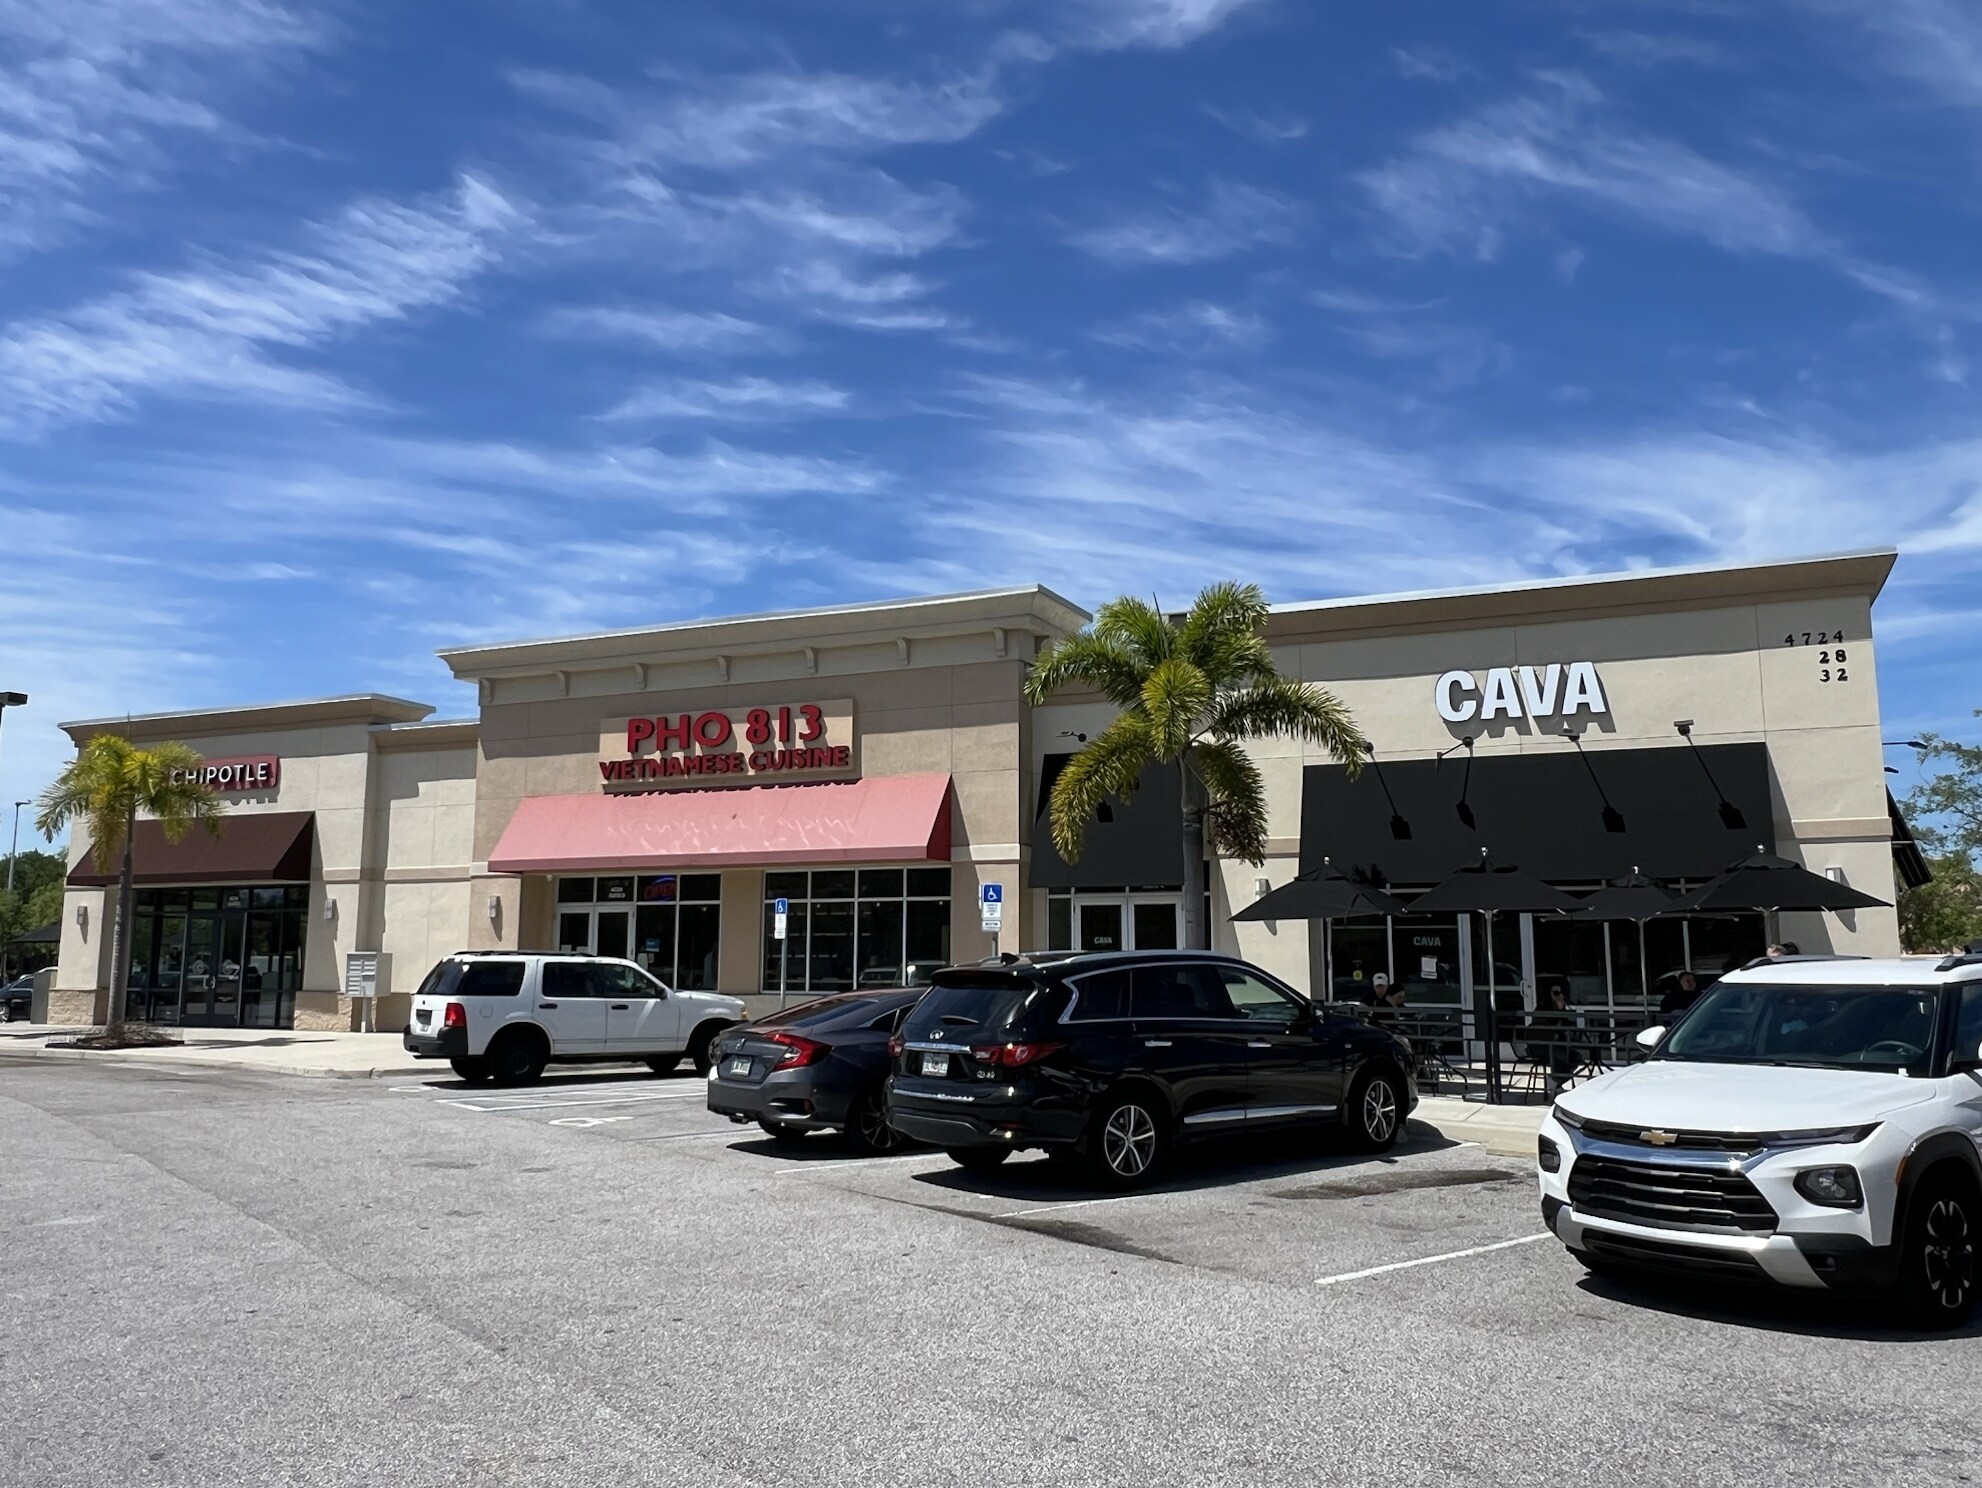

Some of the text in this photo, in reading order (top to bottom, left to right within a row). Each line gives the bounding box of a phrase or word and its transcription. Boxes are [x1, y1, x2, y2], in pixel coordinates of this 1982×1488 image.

[1784, 629, 1844, 647] 4724
[1819, 649, 1847, 663] 28
[1819, 668, 1849, 683] 32
[1435, 661, 1607, 723] CAVA
[627, 704, 823, 753] PHO 813
[599, 745, 850, 780] VIETNAMESE CUISINE
[170, 762, 269, 786] CHIPOTLE
[1094, 936, 1113, 945] CAVA
[1413, 935, 1442, 947] CAVA
